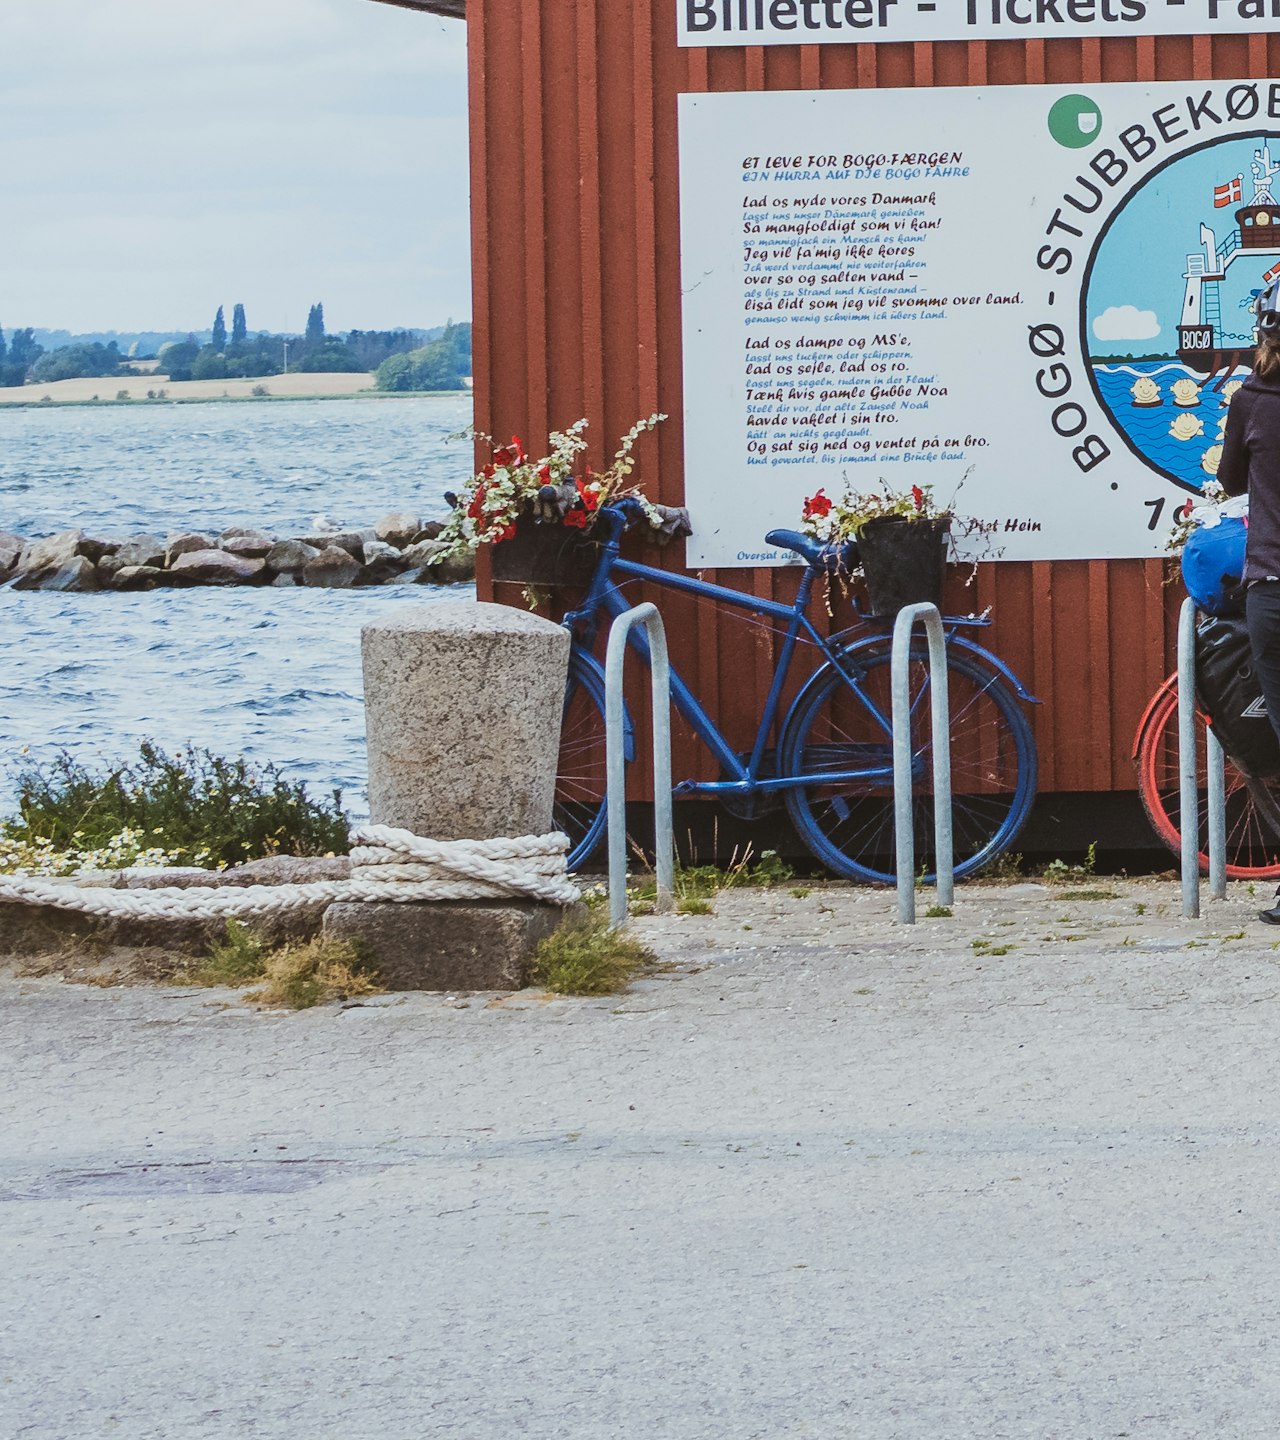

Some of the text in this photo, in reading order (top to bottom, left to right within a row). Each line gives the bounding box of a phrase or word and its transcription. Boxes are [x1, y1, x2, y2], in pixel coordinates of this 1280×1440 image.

[742, 156, 760, 170] ET
[766, 155, 803, 169] LEVE
[808, 155, 837, 168] FOR
[774, 170, 821, 182] HURRA
[825, 168, 851, 181] AUF
[742, 191, 936, 210] Lad os nyde vores Danmark
[742, 213, 769, 222] Lasst
[794, 211, 821, 220] unser
[824, 209, 877, 219] Dänemark
[765, 218, 856, 236] mangfoldigt
[860, 221, 889, 232] som
[894, 218, 906, 230] vi
[910, 217, 942, 232] kan!
[743, 235, 926, 248] so mannigfach ein Mensch es kann!
[744, 247, 768, 263] Jeg
[773, 246, 791, 259] vil
[845, 244, 873, 260] ikke
[744, 260, 927, 273] Ich werd verdammt nie weiterfahren
[744, 275, 772, 285] over
[798, 274, 816, 287] og
[821, 270, 866, 285] salten
[870, 268, 904, 282] vand
[744, 286, 918, 299] als bis zu Strand und Küstenrand
[745, 297, 773, 312] liså
[777, 296, 804, 310] lidt
[809, 299, 838, 311] som
[842, 296, 863, 312] jeg
[868, 295, 887, 308] vil
[952, 296, 980, 306] over
[986, 291, 1024, 305] land.
[745, 311, 948, 326] genauso wenig schwimm ich übers Land.
[745, 336, 769, 350] Lad
[775, 339, 791, 350] os
[795, 335, 843, 350] dampe
[848, 337, 865, 350] og
[1182, 330, 1210, 350] BOGØ
[745, 354, 772, 363] Lasst
[775, 354, 793, 362] uns
[796, 352, 834, 362] tuckern
[836, 352, 860, 361] oder
[746, 359, 909, 376] lad os sejle, lad os ro.
[746, 379, 772, 389] lasst
[776, 379, 794, 388] uns
[838, 378, 871, 386] rudern
[874, 378, 884, 386] in
[887, 376, 902, 385] der
[746, 384, 948, 403] Tænk hvis gamle Gubbe Noa
[1028, 323, 1111, 473] BOGØ
[746, 403, 772, 414] Stell
[775, 404, 791, 413] dir
[815, 404, 830, 412] der
[834, 403, 857, 413] alte
[859, 401, 896, 412] Zausel
[900, 400, 929, 410] Noah
[746, 411, 899, 428] havde vaklet i sin tro.
[789, 428, 820, 439] nichts
[823, 427, 873, 440] geglaubt.
[747, 434, 990, 456] Og sat sig ned og ventet på en bro.
[747, 456, 768, 466] Und
[821, 453, 835, 465] bis
[838, 455, 877, 464] jemand
[880, 454, 900, 462] eine
[903, 451, 938, 463] Brücke
[940, 451, 967, 461] baut.
[1004, 518, 1042, 533] Hein
[737, 550, 778, 561] Oversat
